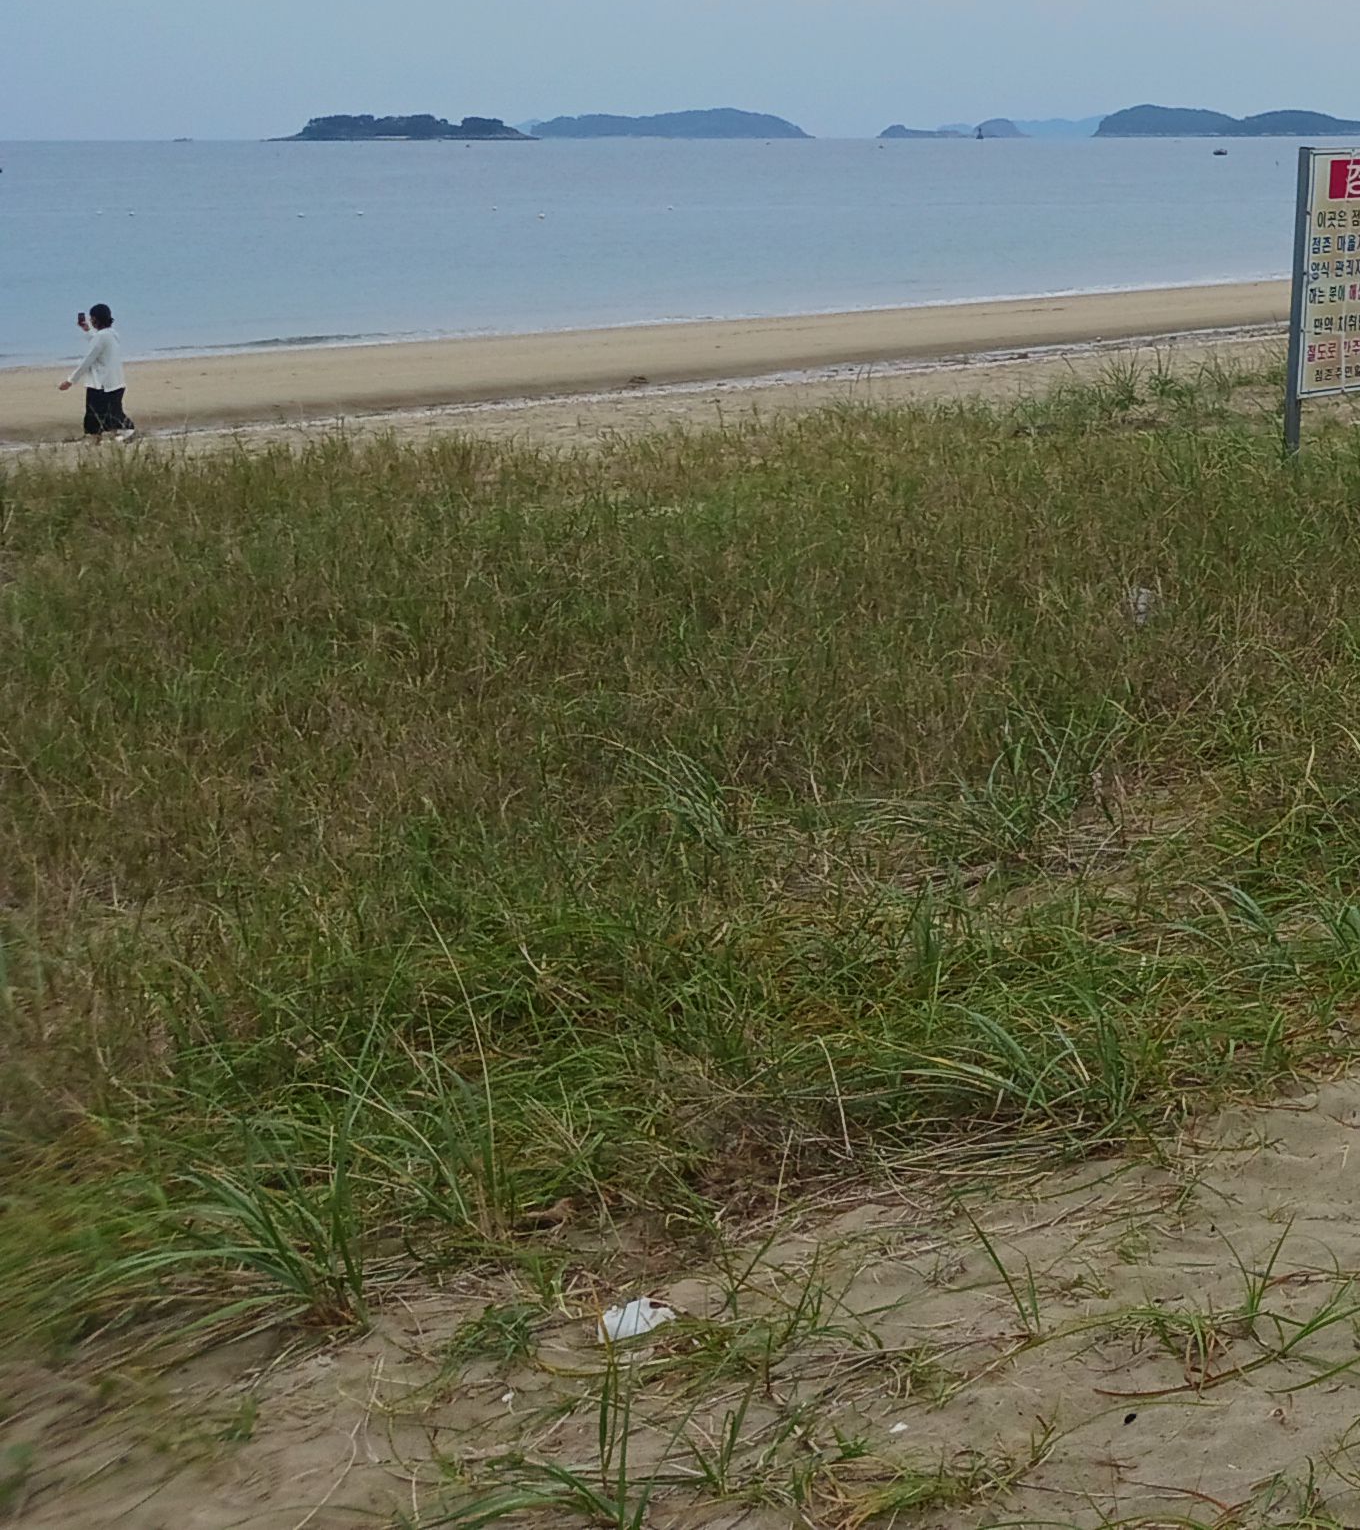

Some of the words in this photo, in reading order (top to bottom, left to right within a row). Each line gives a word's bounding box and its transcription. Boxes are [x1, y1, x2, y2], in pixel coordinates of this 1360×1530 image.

[1317, 210, 1347, 229] 이곳은
[1310, 261, 1330, 280] 양식
[1308, 287, 1325, 304] 하는
[1313, 317, 1334, 336] 만약
